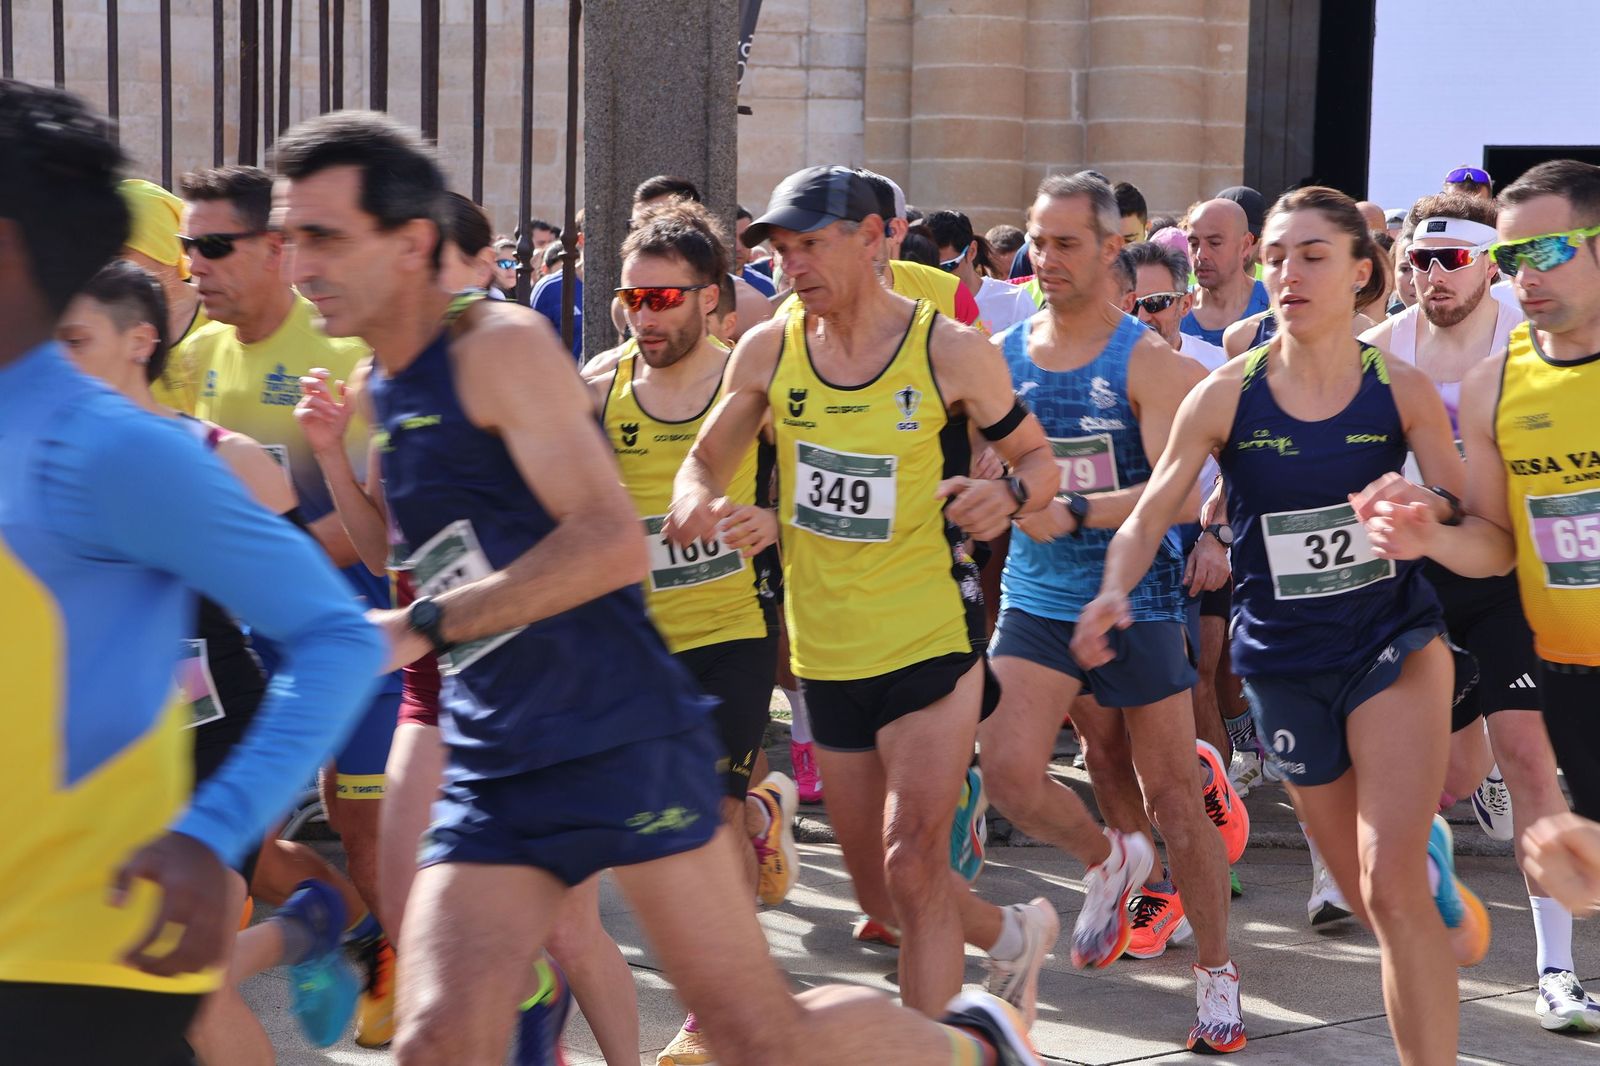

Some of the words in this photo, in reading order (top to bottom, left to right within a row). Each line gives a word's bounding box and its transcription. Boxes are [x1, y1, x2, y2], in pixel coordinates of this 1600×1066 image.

[808, 470, 871, 516] 349
[1305, 529, 1355, 570] 32
[1552, 516, 1600, 560] 65
